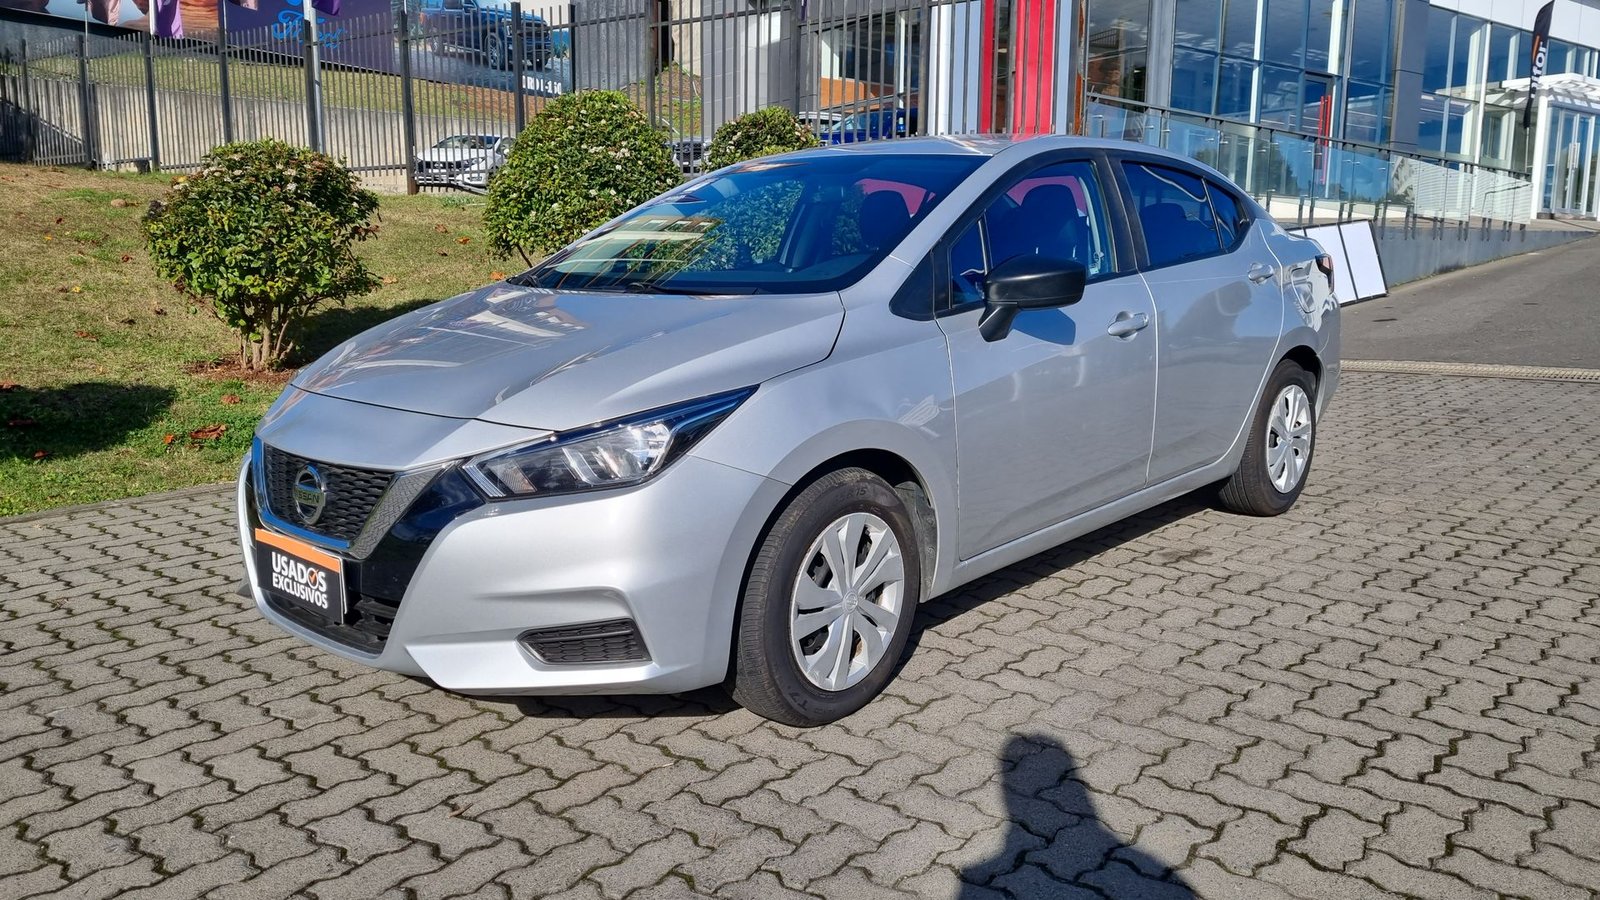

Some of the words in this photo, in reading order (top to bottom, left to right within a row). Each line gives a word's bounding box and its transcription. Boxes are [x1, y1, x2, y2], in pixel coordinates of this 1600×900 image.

[272, 9, 347, 48] Frd
[271, 551, 327, 592] USADOS
[272, 572, 329, 609] EXCLUSIVOS
